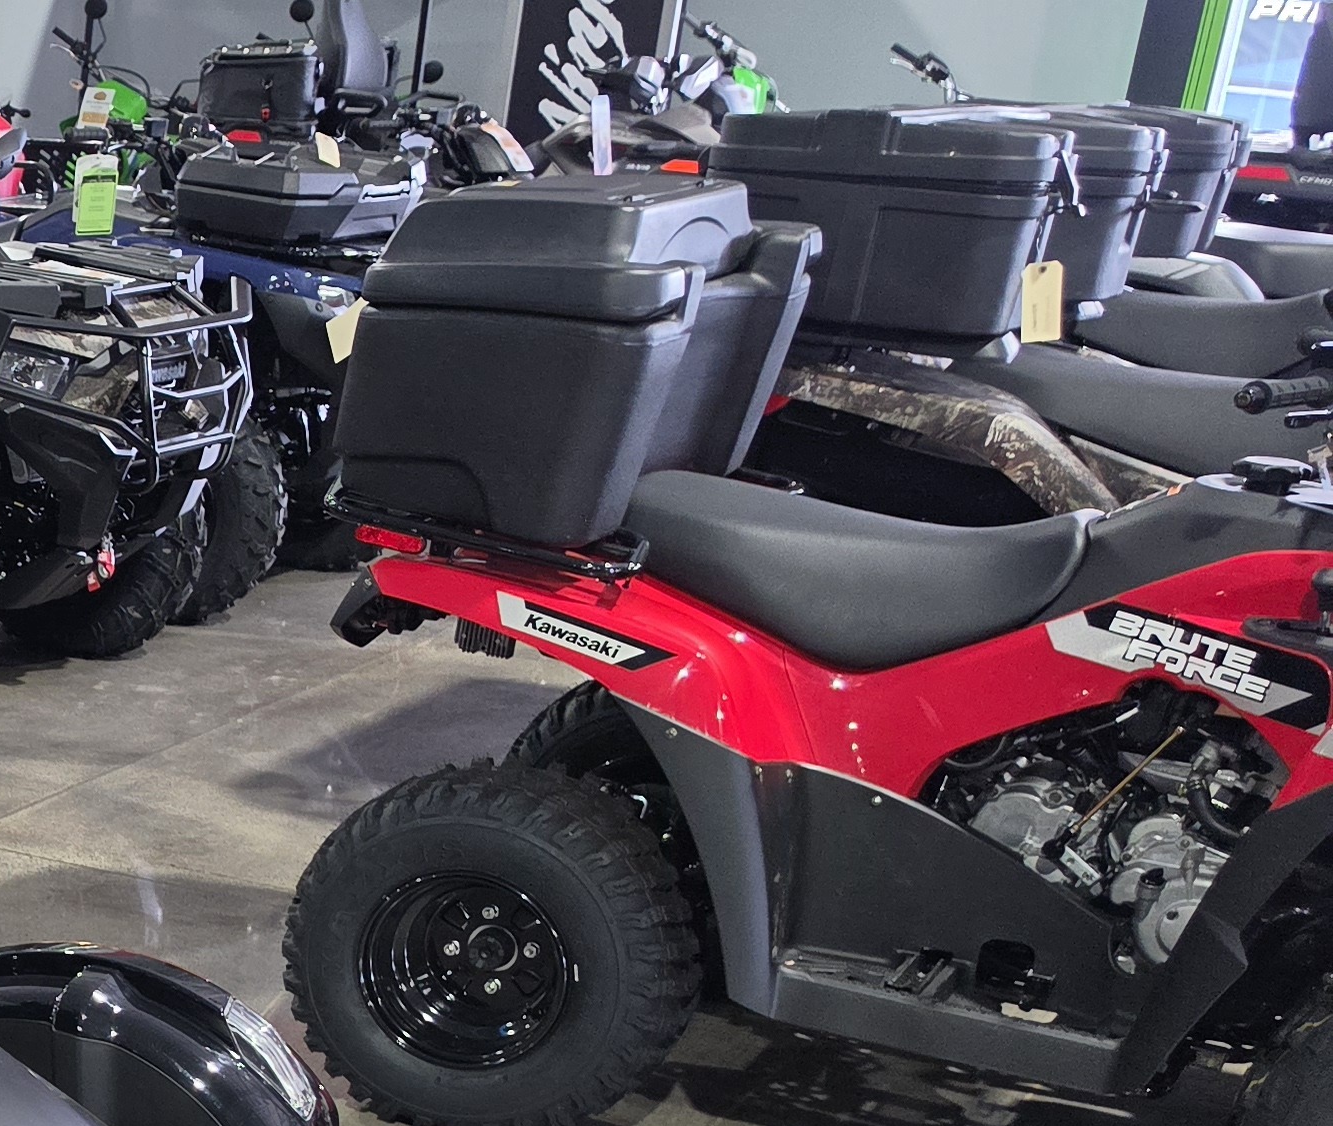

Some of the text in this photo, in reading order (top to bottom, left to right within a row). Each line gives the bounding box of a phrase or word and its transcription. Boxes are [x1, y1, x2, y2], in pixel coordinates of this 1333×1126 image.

[524, 614, 621, 659] Kawasaki
[1109, 610, 1257, 673] BRUTE
[1122, 638, 1271, 702] FORCE
